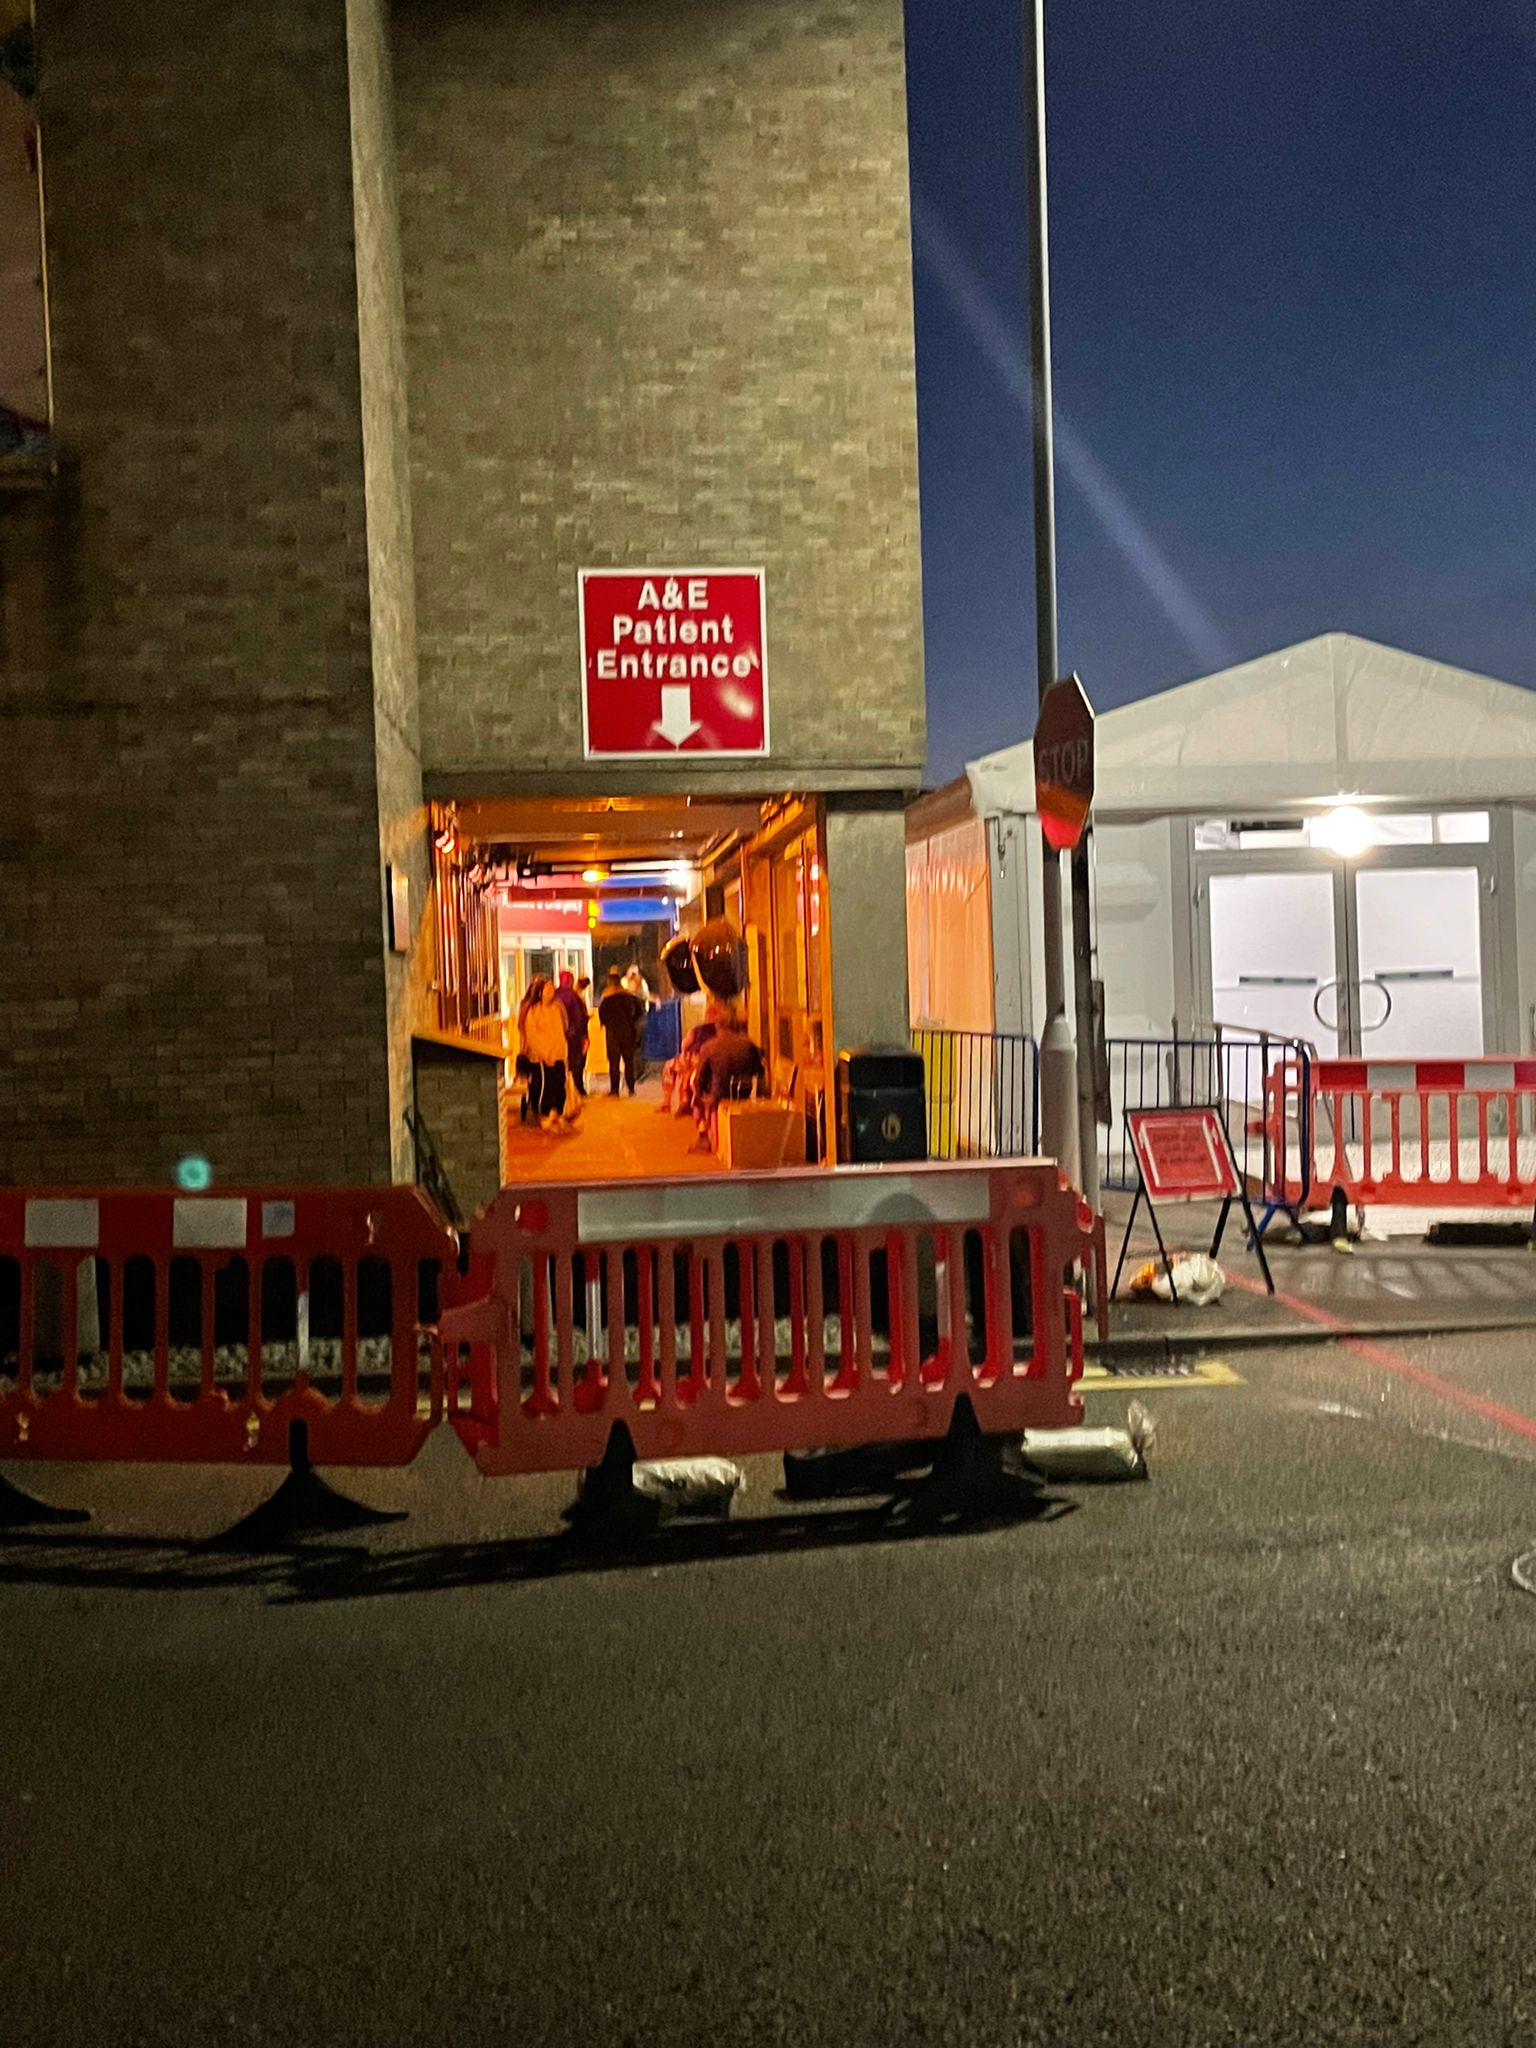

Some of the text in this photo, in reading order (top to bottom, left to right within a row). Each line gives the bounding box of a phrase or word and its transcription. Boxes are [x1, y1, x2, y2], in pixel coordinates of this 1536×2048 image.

[637, 578, 709, 611] A&E
[613, 613, 734, 645] Patient
[597, 648, 751, 679] Entrance
[1037, 738, 1089, 789] STOP
